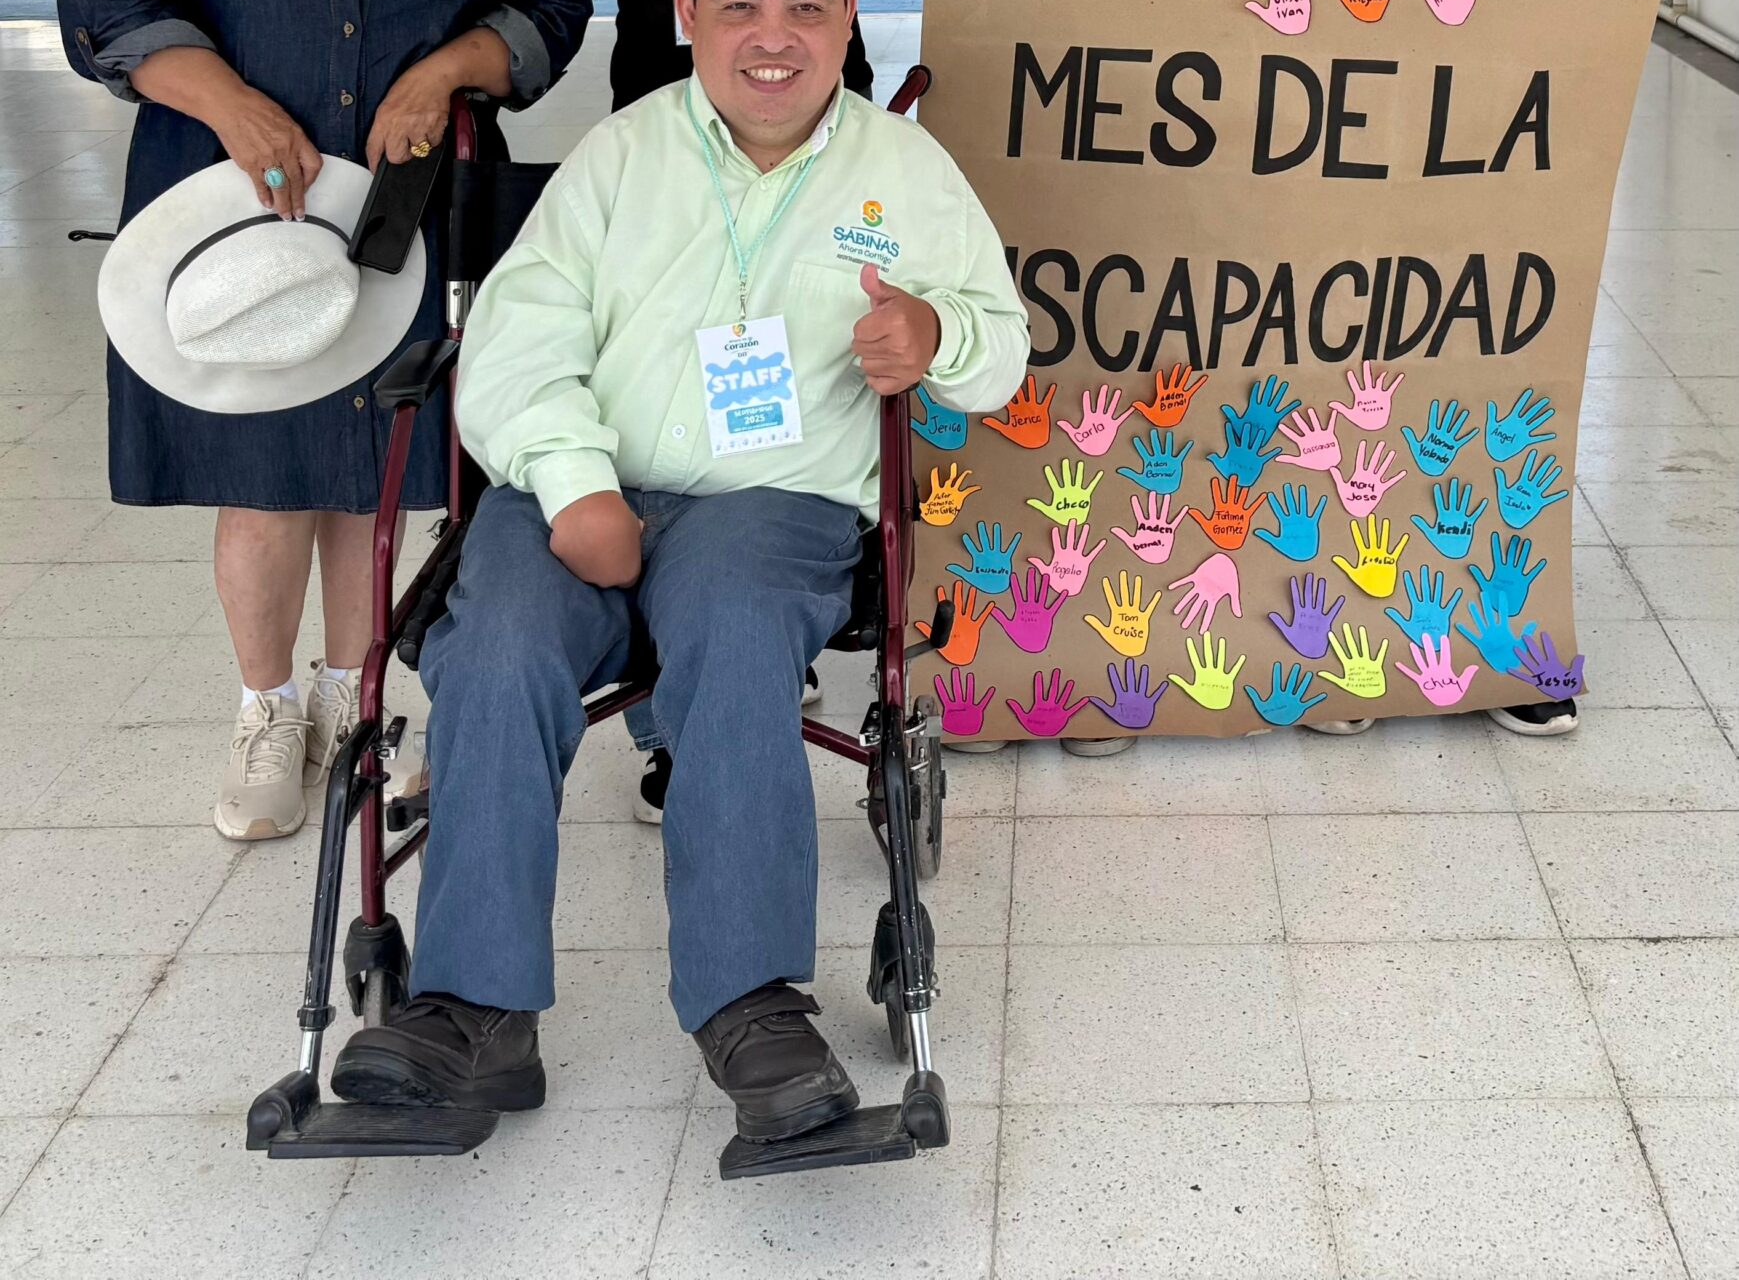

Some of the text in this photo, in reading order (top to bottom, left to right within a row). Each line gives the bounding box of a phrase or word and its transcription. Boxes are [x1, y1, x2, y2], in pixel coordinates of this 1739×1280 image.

[1006, 42, 1551, 180] MES DE LA
[833, 226, 900, 258] SABINAS
[838, 243, 863, 255] Ahora
[1005, 246, 1557, 373] SCAPACIDAD
[711, 366, 783, 394] STAFF
[1073, 422, 1105, 443] Carla
[1118, 613, 1139, 622] Tom
